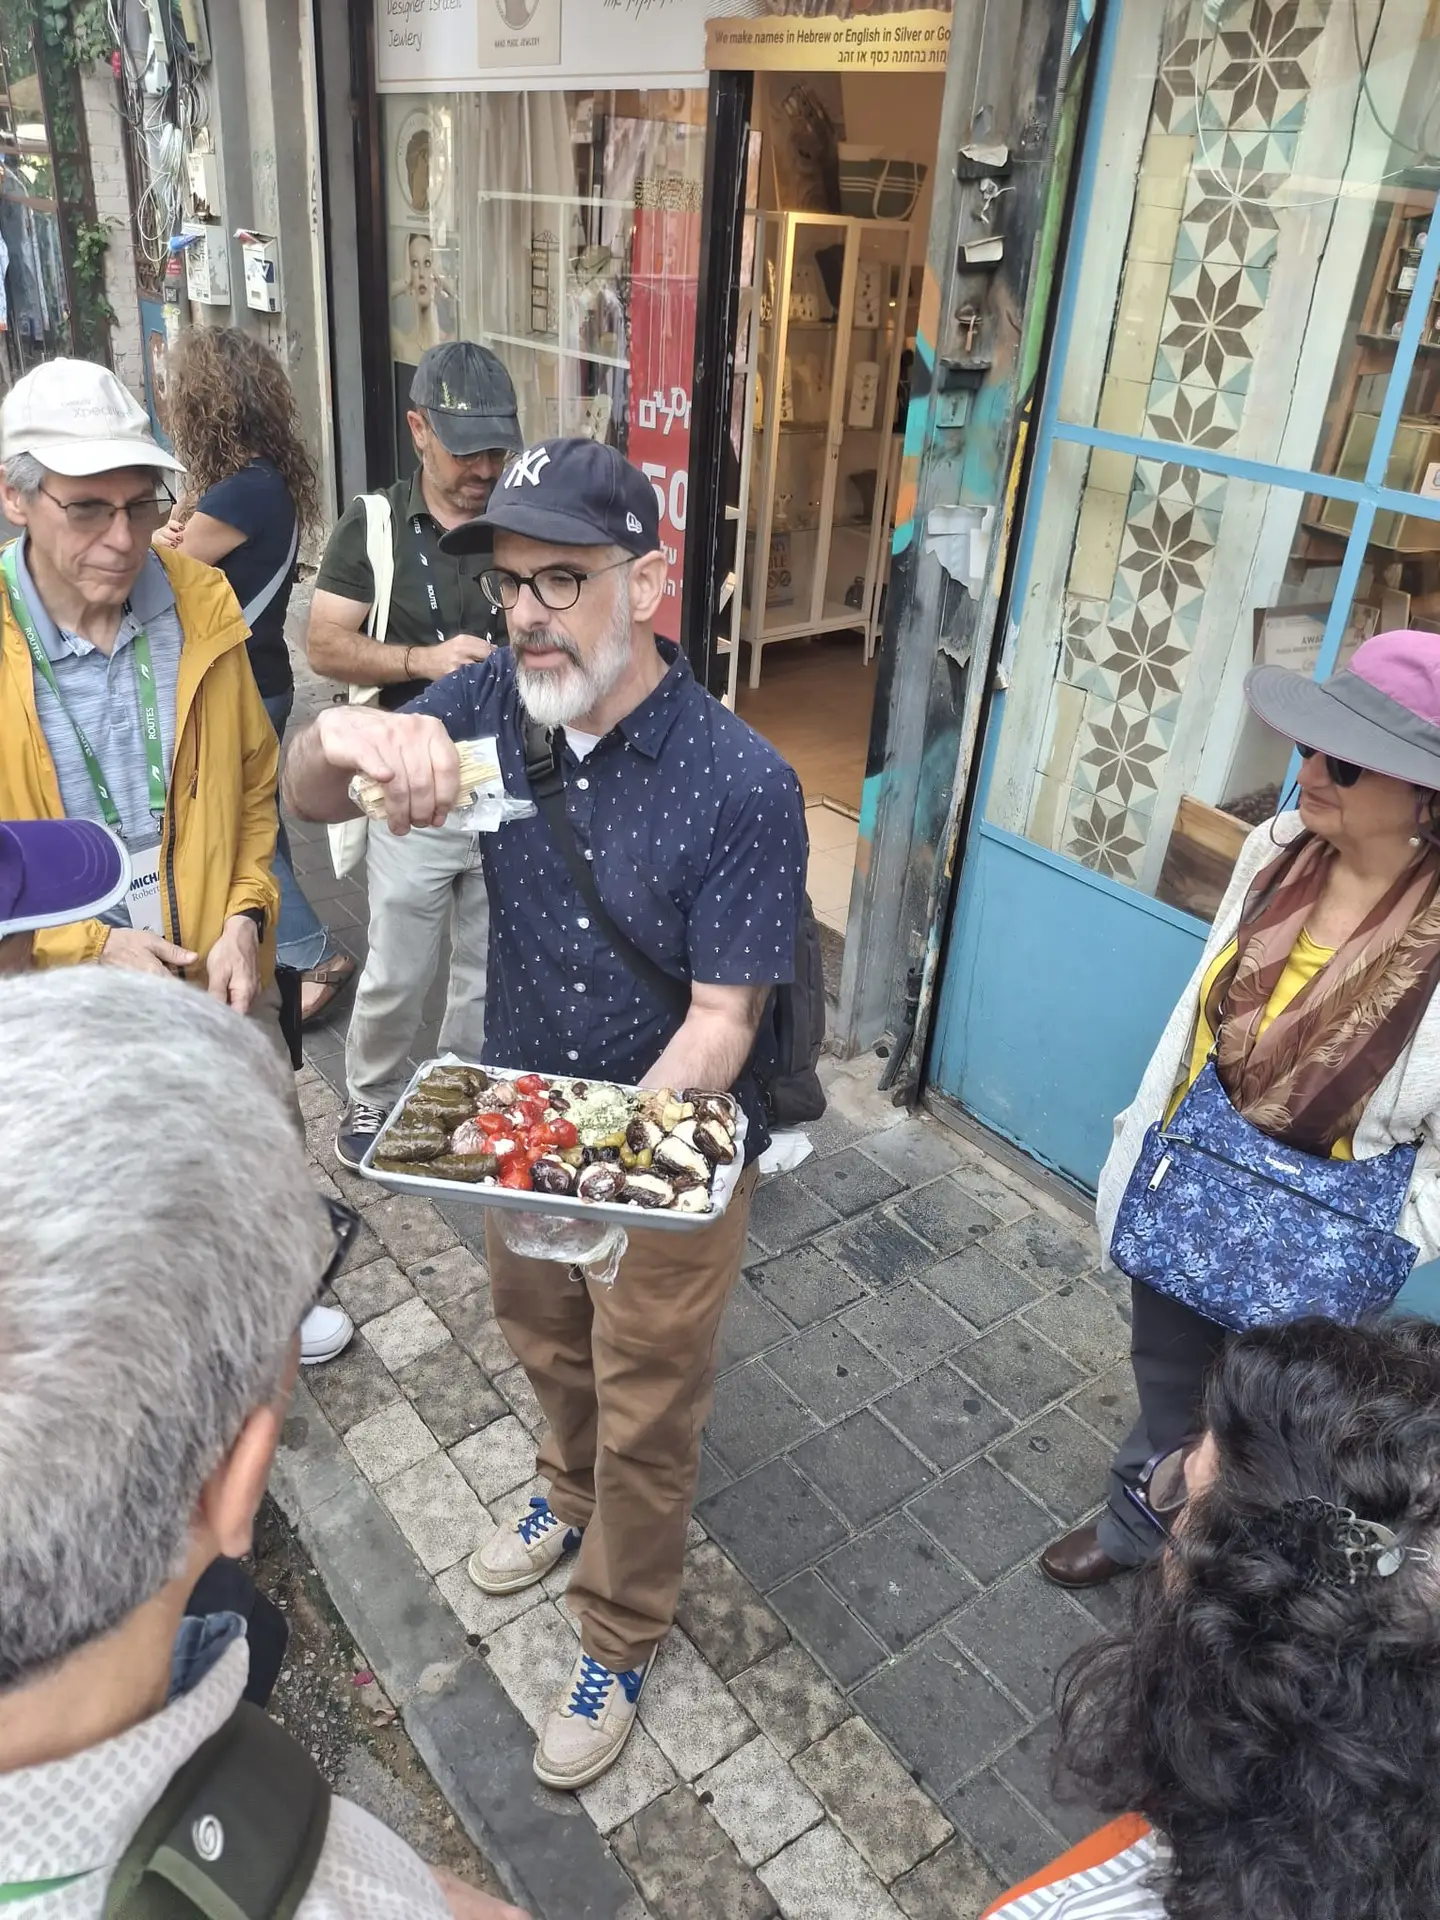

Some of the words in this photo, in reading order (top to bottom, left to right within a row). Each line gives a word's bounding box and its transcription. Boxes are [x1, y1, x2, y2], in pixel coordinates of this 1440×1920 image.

[388, 28, 423, 51] Jewlery
[715, 31, 727, 44] We
[729, 30, 753, 43] make
[755, 31, 784, 43] names
[786, 29, 795, 43] in
[796, 29, 831, 43] Hebrew
[833, 32, 843, 42] or
[845, 27, 880, 46] English
[882, 27, 892, 42] in
[894, 26, 922, 41] Silver
[924, 29, 936, 41] or
[937, 25, 952, 41] Go
[837, 50, 855, 63] זהב
[856, 50, 868, 63] או
[870, 50, 890, 67] כסף
[891, 50, 926, 63] בהזמנה
[928, 49, 948, 63] מות
[503, 447, 551, 489] NY
[426, 584, 438, 610] ROUTES
[24, 626, 44, 661] ROUTES
[145, 707, 158, 740] ROUTES
